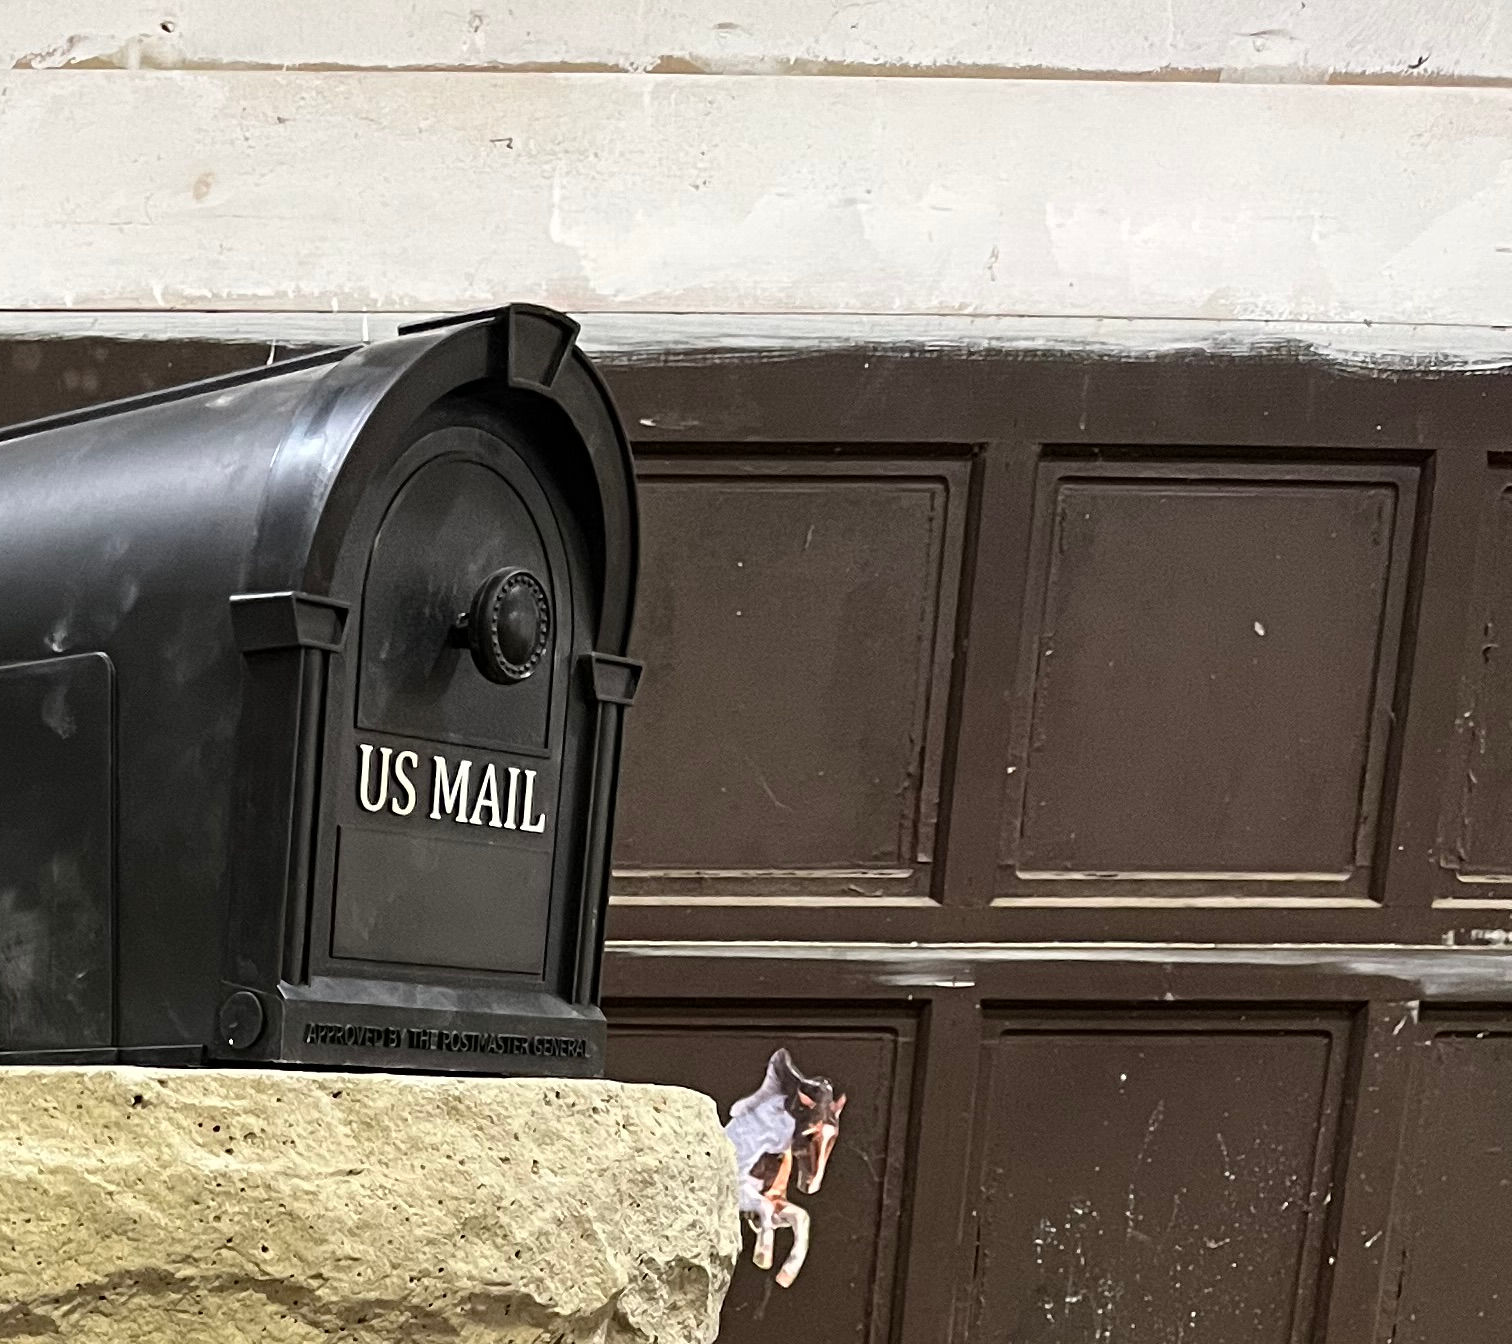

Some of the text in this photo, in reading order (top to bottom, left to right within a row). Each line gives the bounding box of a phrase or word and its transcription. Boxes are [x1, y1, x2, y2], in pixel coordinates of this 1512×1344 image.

[358, 744, 547, 834] US MAIL
[304, 1022, 592, 1059] APPROVED BY THE POSTMASTER GENERAL
